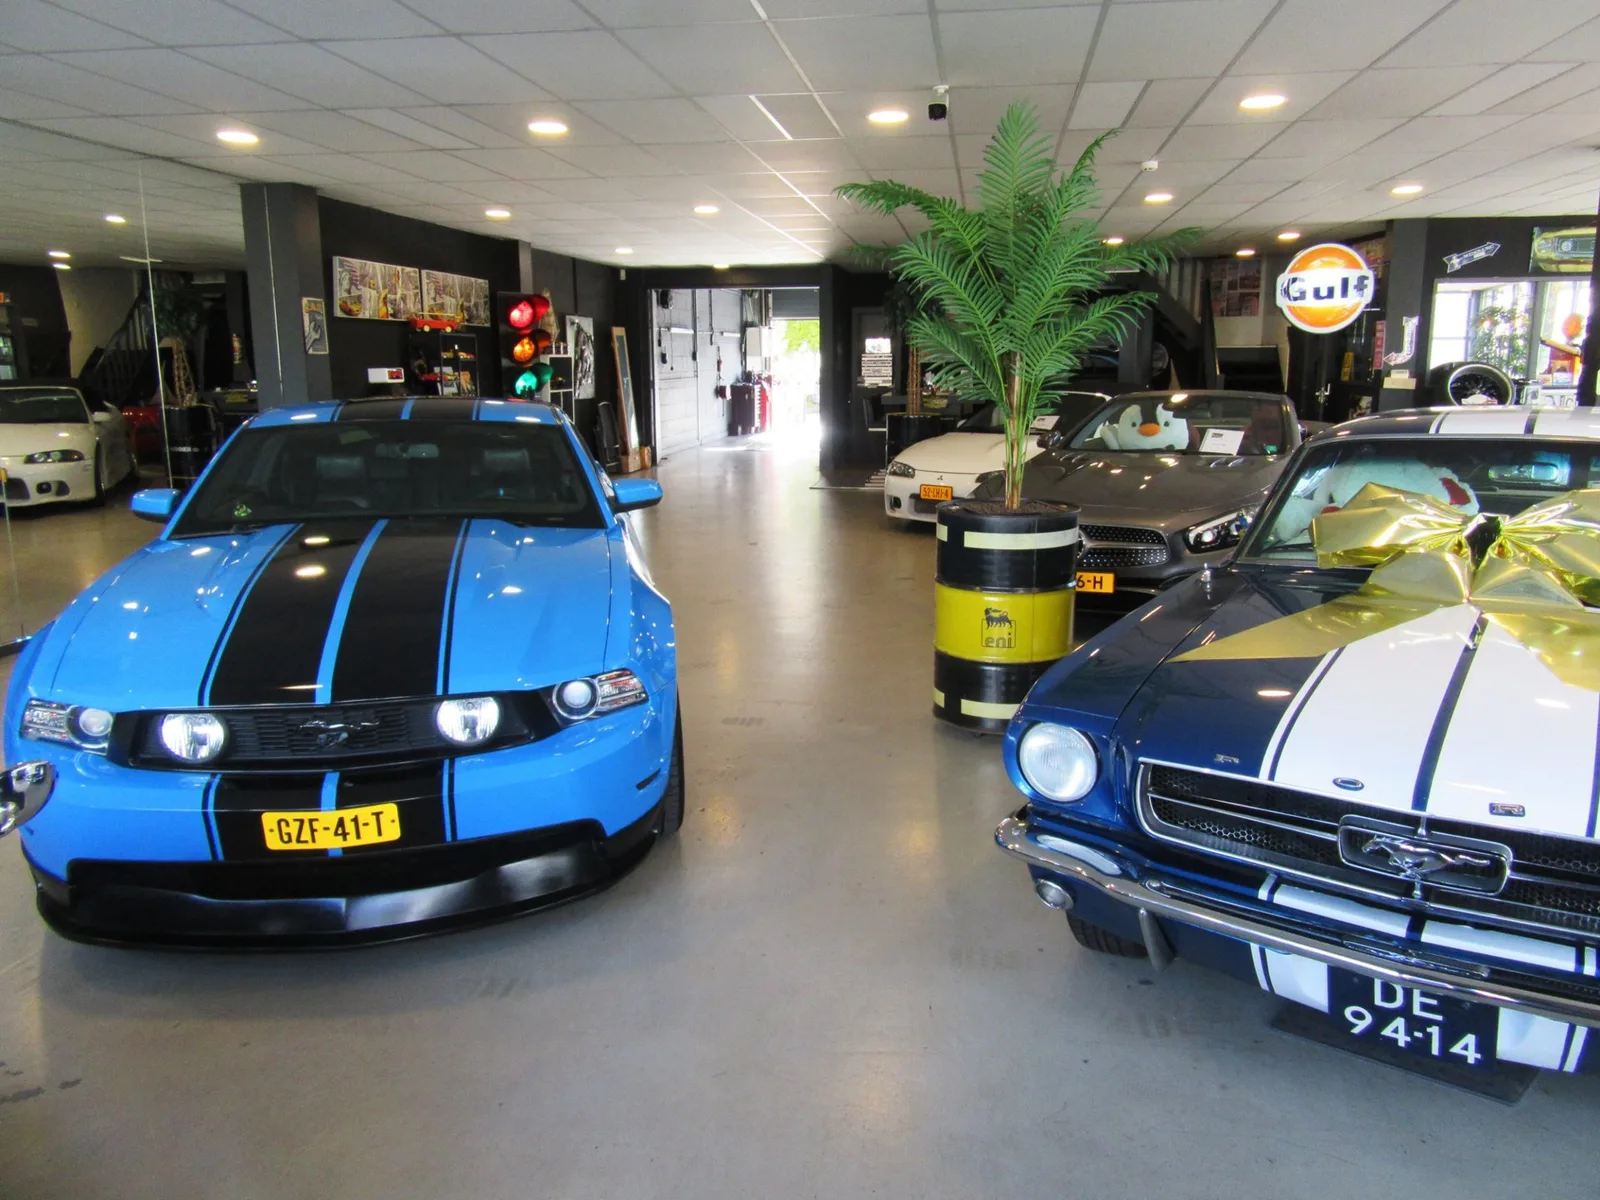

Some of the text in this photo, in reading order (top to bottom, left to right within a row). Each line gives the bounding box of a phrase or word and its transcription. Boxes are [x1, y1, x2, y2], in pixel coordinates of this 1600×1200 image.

[1281, 275, 1370, 302] Gulf
[985, 632, 1012, 648] eni
[276, 811, 384, 844] GZF-41-T
[1374, 978, 1443, 1021] DE
[1344, 1005, 1482, 1065] 94-14
